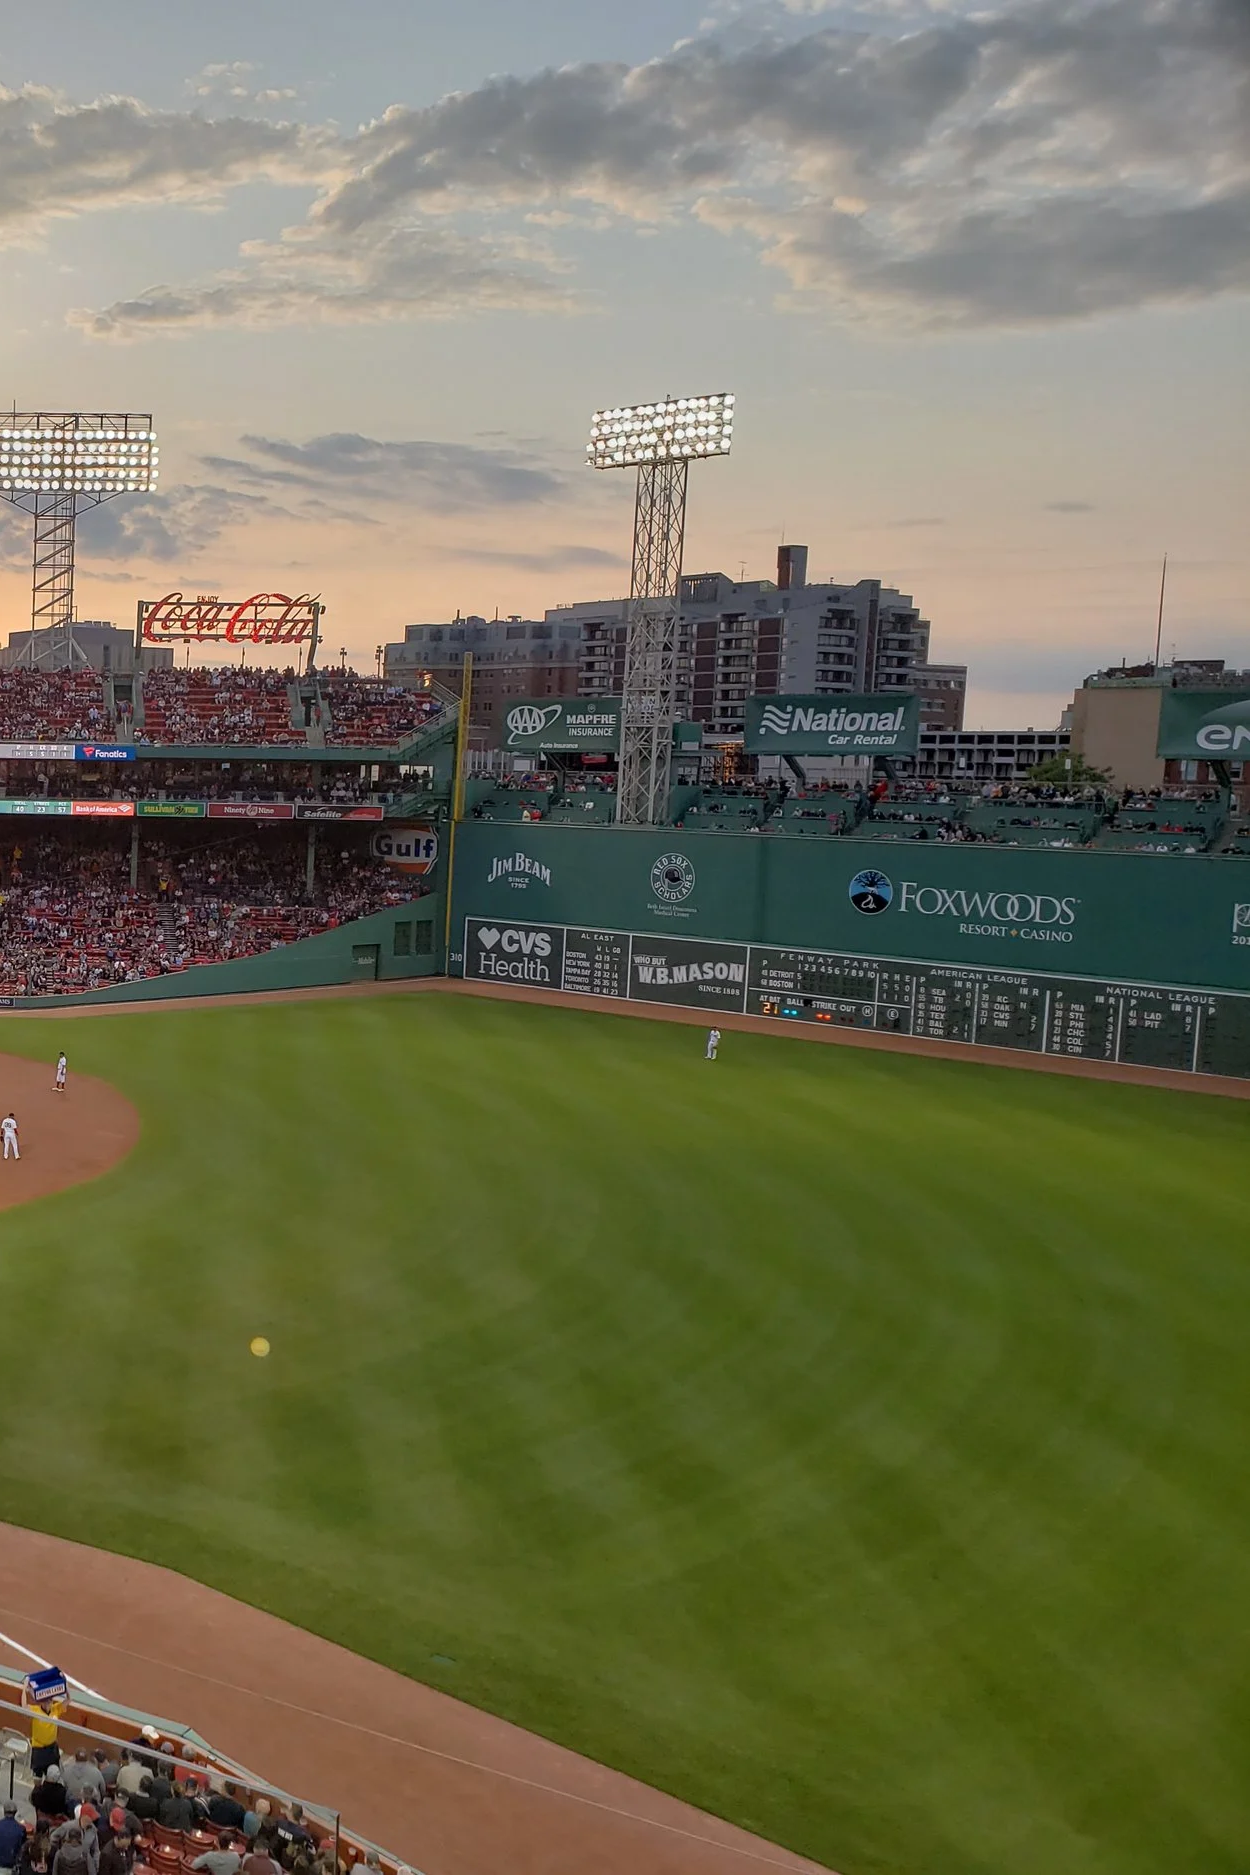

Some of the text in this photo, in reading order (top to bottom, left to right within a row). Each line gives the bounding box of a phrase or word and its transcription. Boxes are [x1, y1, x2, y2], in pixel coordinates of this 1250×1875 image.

[197, 595, 219, 603] ENJOY
[512, 708, 541, 733] AAA
[566, 714, 616, 724] MAPFRE
[791, 706, 904, 732] National
[568, 728, 613, 737] INSURANCE
[828, 734, 897, 745] Car Rental
[95, 750, 127, 758] Fanatics
[224, 806, 275, 816] Ninety Nine
[303, 809, 342, 819] Safelite
[375, 834, 434, 859] Gulf
[488, 852, 551, 887] JIM BEAM
[653, 855, 689, 875] RED SOX
[654, 874, 693, 900] SCHOLARS
[898, 881, 1076, 925] FOXWOODS
[959, 923, 1073, 943] RESORT CASINO
[501, 929, 551, 957] CVS
[450, 952, 463, 962] 310
[566, 951, 587, 959] BOSTON
[565, 958, 577, 966] NEW
[633, 956, 666, 965] WHO BUT
[780, 953, 879, 969] FENWAY PARK
[478, 951, 550, 981] Health
[638, 962, 745, 985] W.B.MASON
[834, 967, 840, 975] 6
[851, 969, 857, 977] 8
[894, 973, 900, 981] H
[930, 969, 1029, 985] AMERICAN LEAGUE
[565, 975, 590, 983] TORONTO
[768, 979, 794, 988] BOSTON
[769, 970, 795, 979] DETROIT
[894, 983, 900, 991] 5
[564, 983, 592, 992] BALTIMORE
[698, 985, 721, 993] SINCE
[931, 988, 947, 996] SEA
[966, 981, 972, 989] R
[1032, 988, 1039, 996] R
[933, 996, 944, 1004] TB
[996, 995, 1009, 1003] KC
[1106, 986, 1216, 1005] NATIONAL LEAGUE
[786, 998, 804, 1006] BALL
[811, 1001, 837, 1010] STRIKE
[839, 1004, 856, 1012] OUT
[993, 1003, 1010, 1011] OAK
[1056, 991, 1063, 999] P
[1109, 996, 1116, 1004] R
[1185, 1004, 1193, 1013] R
[1208, 1007, 1216, 1015] P
[1070, 1003, 1085, 1012] MIA
[763, 1002, 778, 1015] 21
[930, 1004, 946, 1012] HOU
[930, 1012, 945, 1020] TEX
[993, 1011, 1010, 1020] CWS
[1069, 1011, 1086, 1020] STL
[1144, 1011, 1162, 1020] LAD
[929, 1020, 944, 1028] BAL
[1069, 1020, 1084, 1029] PHI
[1144, 1020, 1160, 1029] PIT
[929, 1027, 944, 1036] TOR
[1066, 1028, 1086, 1037] CHC
[1066, 1037, 1084, 1046] COL
[1067, 1045, 1082, 1054] CIN
